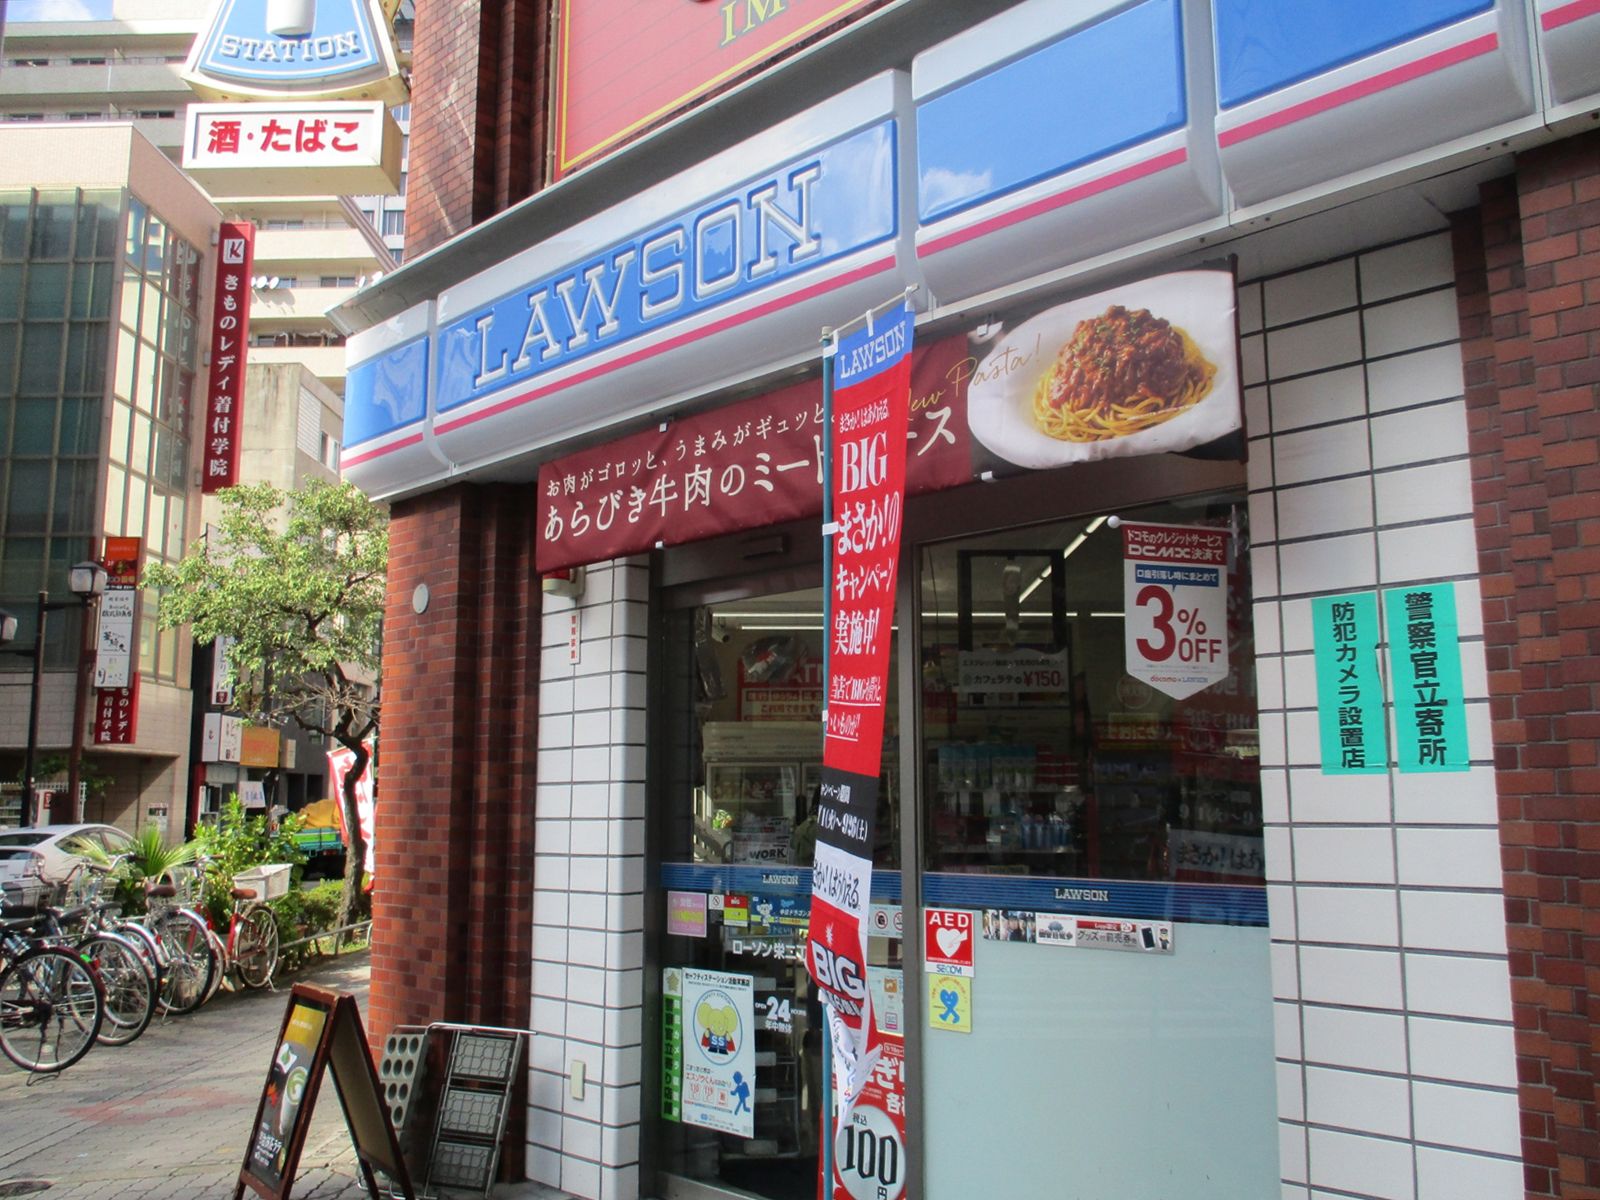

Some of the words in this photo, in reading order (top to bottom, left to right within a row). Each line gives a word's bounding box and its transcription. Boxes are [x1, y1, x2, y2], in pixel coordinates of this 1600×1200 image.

[219, 31, 361, 63] STATION
[207, 119, 360, 154] 酒・たばこ
[473, 160, 822, 390] LAWSON
[840, 320, 906, 379] LAWSON
[946, 333, 1041, 398] Pasta!
[209, 273, 238, 477] きものレディ着付学院
[544, 406, 956, 542] あらびき牛肉のミートス
[839, 431, 889, 494] BIG
[1127, 529, 1223, 547] ドコモのクレジットサービス
[835, 557, 895, 601] キャンペーン
[834, 607, 880, 656] 実施中!
[1178, 638, 1222, 663] OFF
[1023, 670, 1062, 687] ¥150
[1331, 602, 1366, 769] 防犯カメラ設置店
[1404, 591, 1448, 766] 警察官立寄所
[762, 874, 799, 885] LAWSON
[1055, 887, 1109, 902] LAWSON
[928, 911, 970, 928] AED
[811, 939, 866, 1000] BIG
[936, 964, 963, 976] SECOM
[766, 995, 791, 1022] 24
[711, 1036, 725, 1047] SS
[841, 1124, 899, 1186] 100
